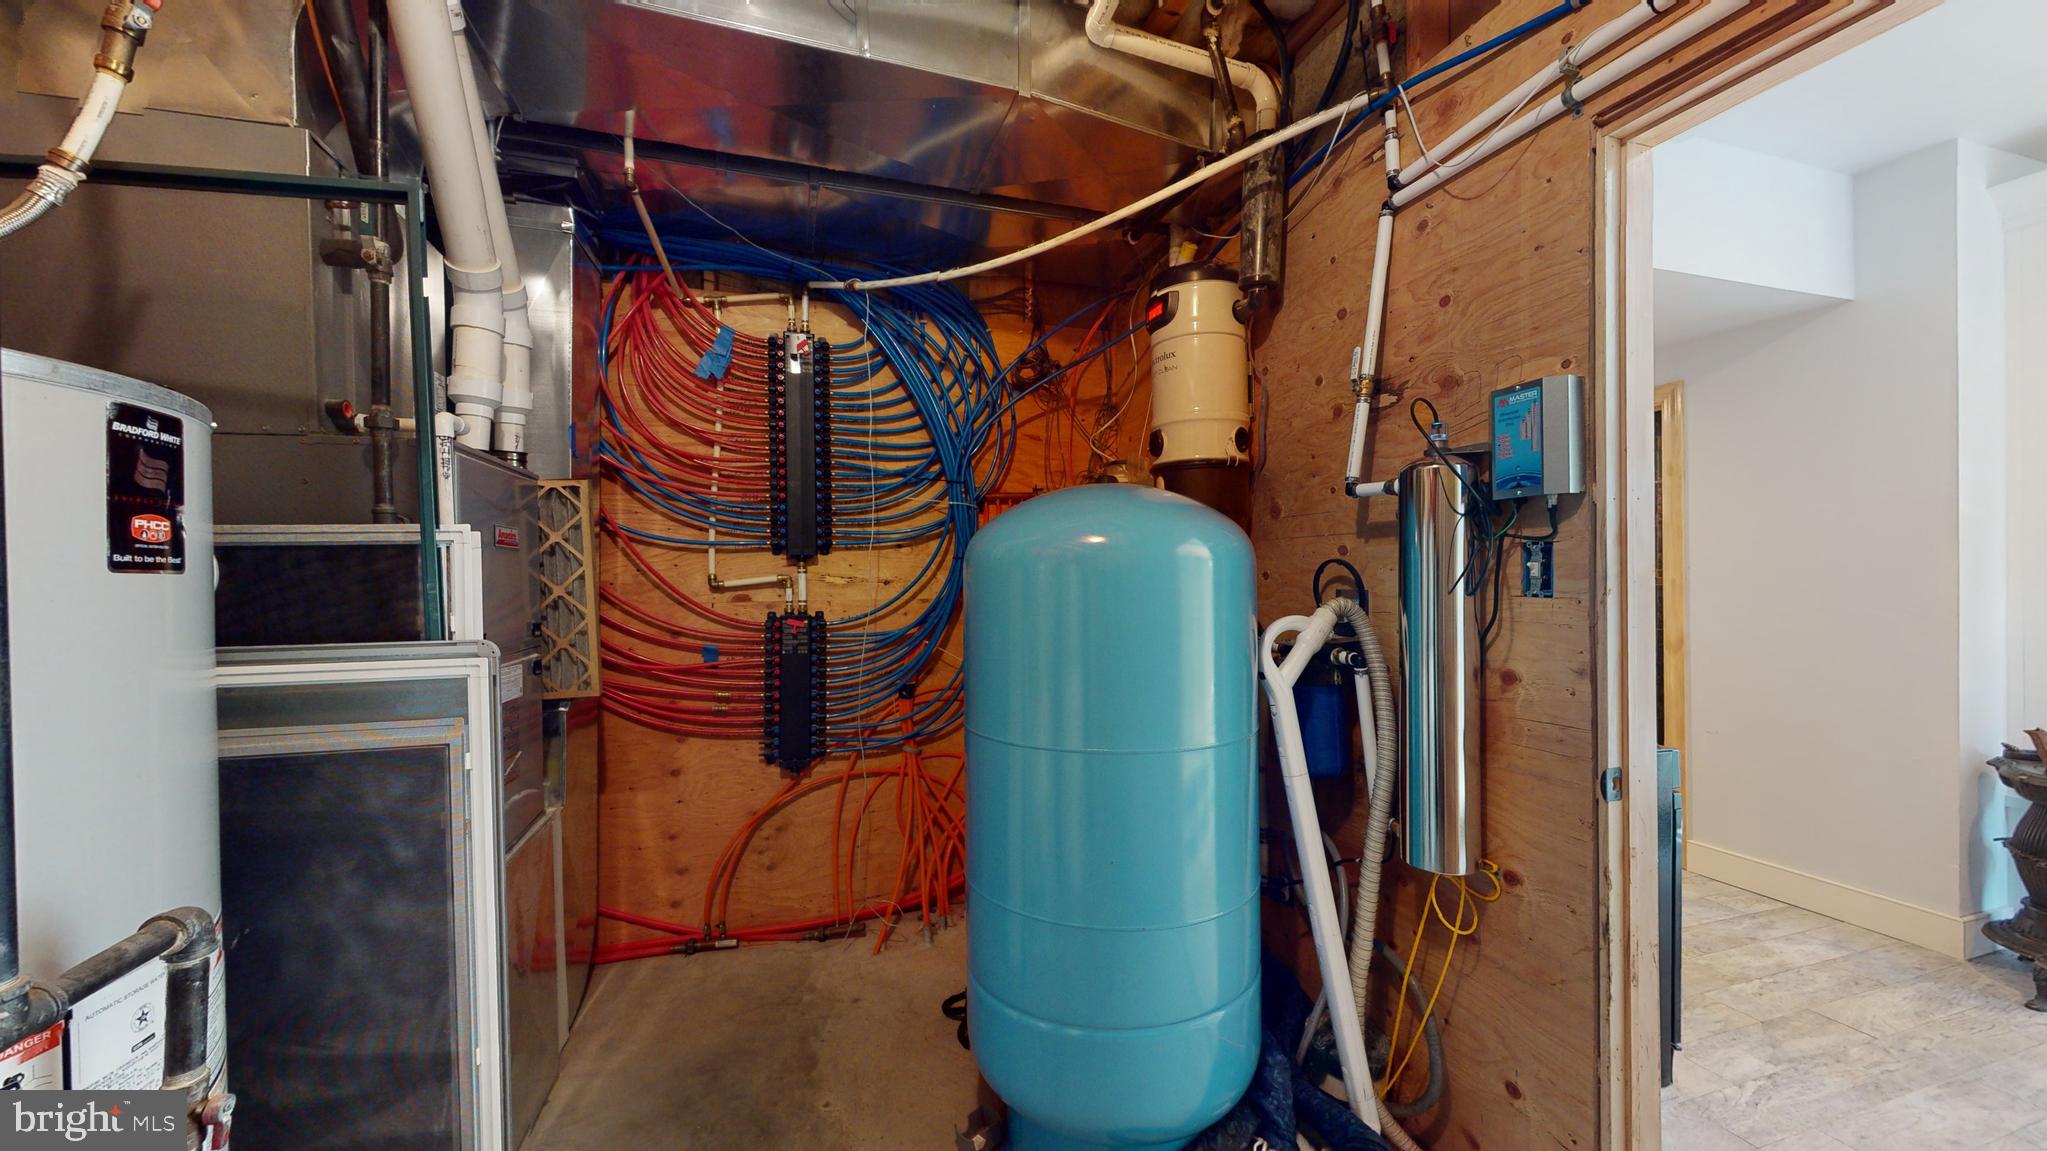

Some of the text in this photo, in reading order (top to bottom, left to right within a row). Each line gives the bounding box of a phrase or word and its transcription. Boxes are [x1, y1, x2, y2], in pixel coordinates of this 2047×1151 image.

[1509, 390, 1538, 402] MASTER
[112, 421, 182, 445] BRADFORD WHITE
[134, 519, 170, 531] PHCC
[113, 554, 133, 562] Built
[144, 555, 154, 563] be
[85, 997, 123, 1021] AUTOMATIC
[124, 982, 150, 1001] STORAGE
